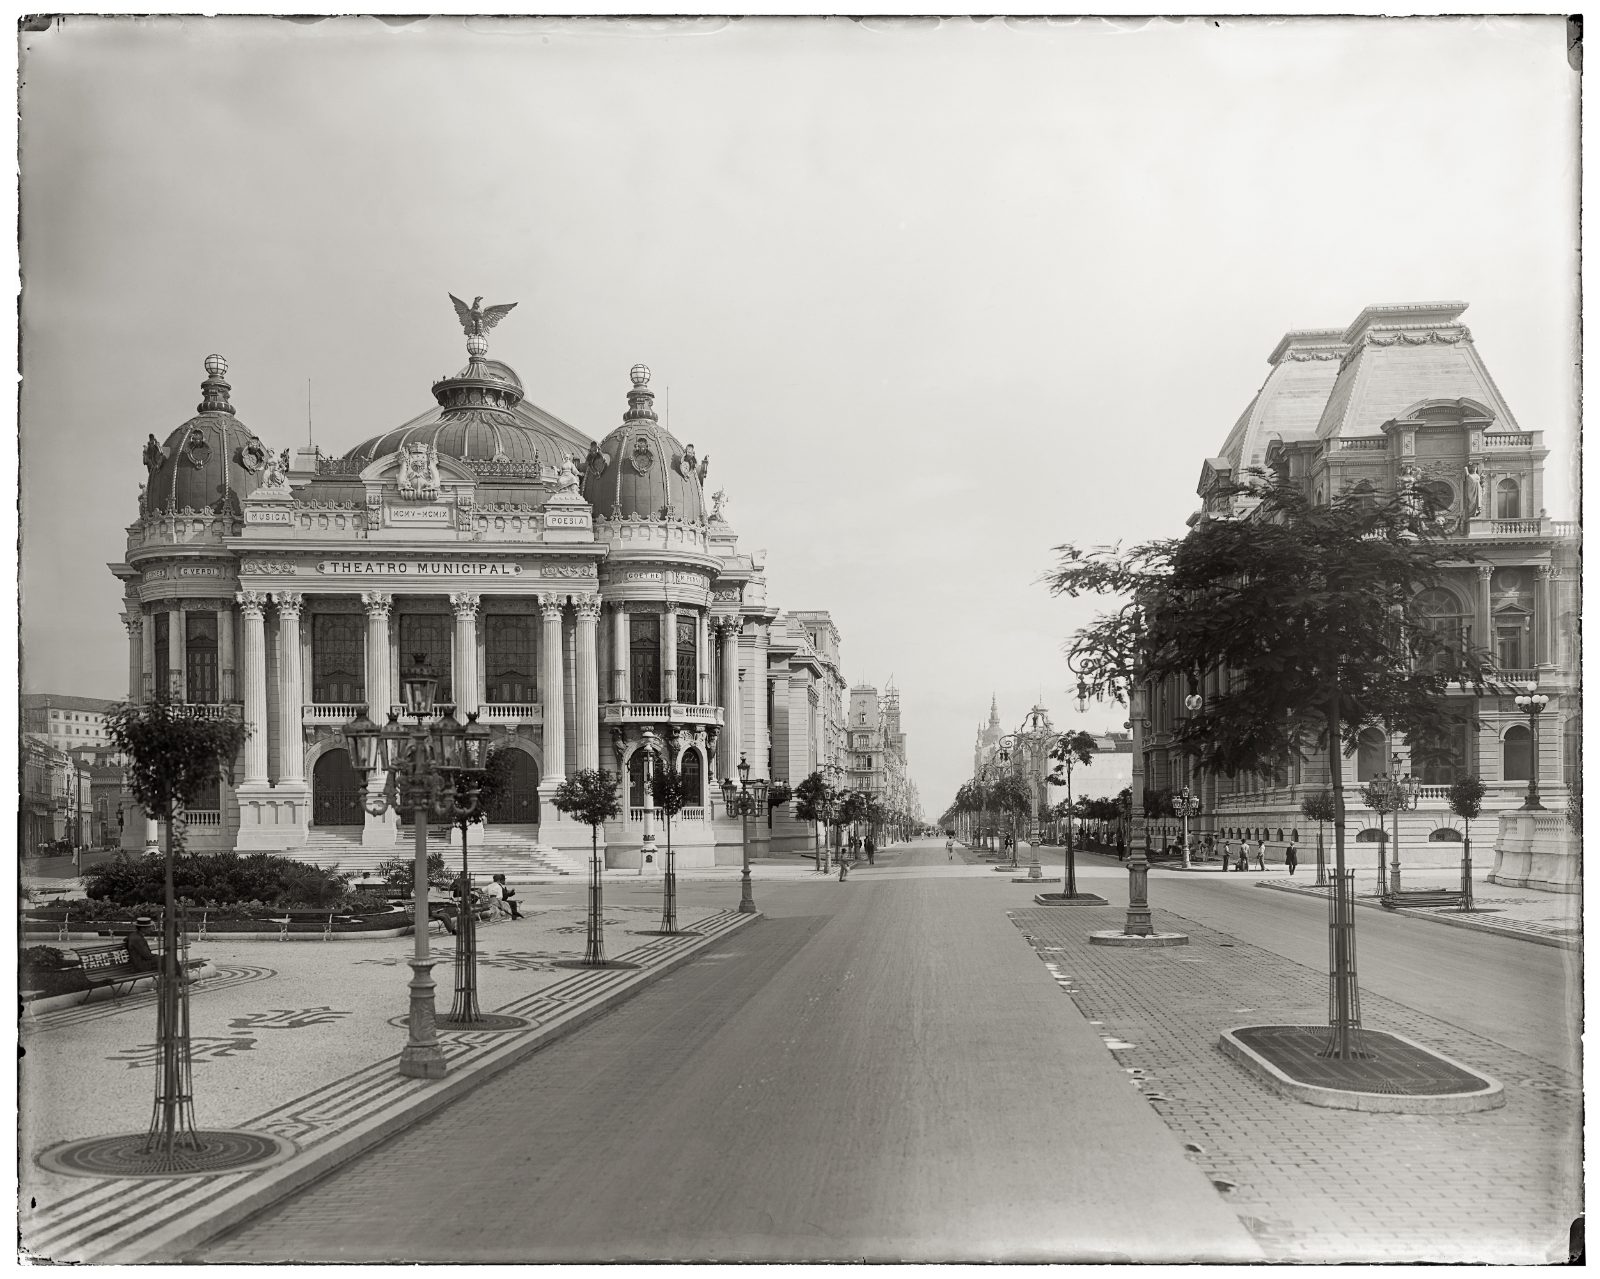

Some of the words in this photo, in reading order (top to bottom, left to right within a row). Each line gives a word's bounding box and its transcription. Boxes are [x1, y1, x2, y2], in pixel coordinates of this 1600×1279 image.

[251, 513, 287, 521] MUSICA
[551, 517, 584, 525] POESIA
[330, 562, 408, 573] THEATRO
[417, 562, 510, 575] MUNICIPAL
